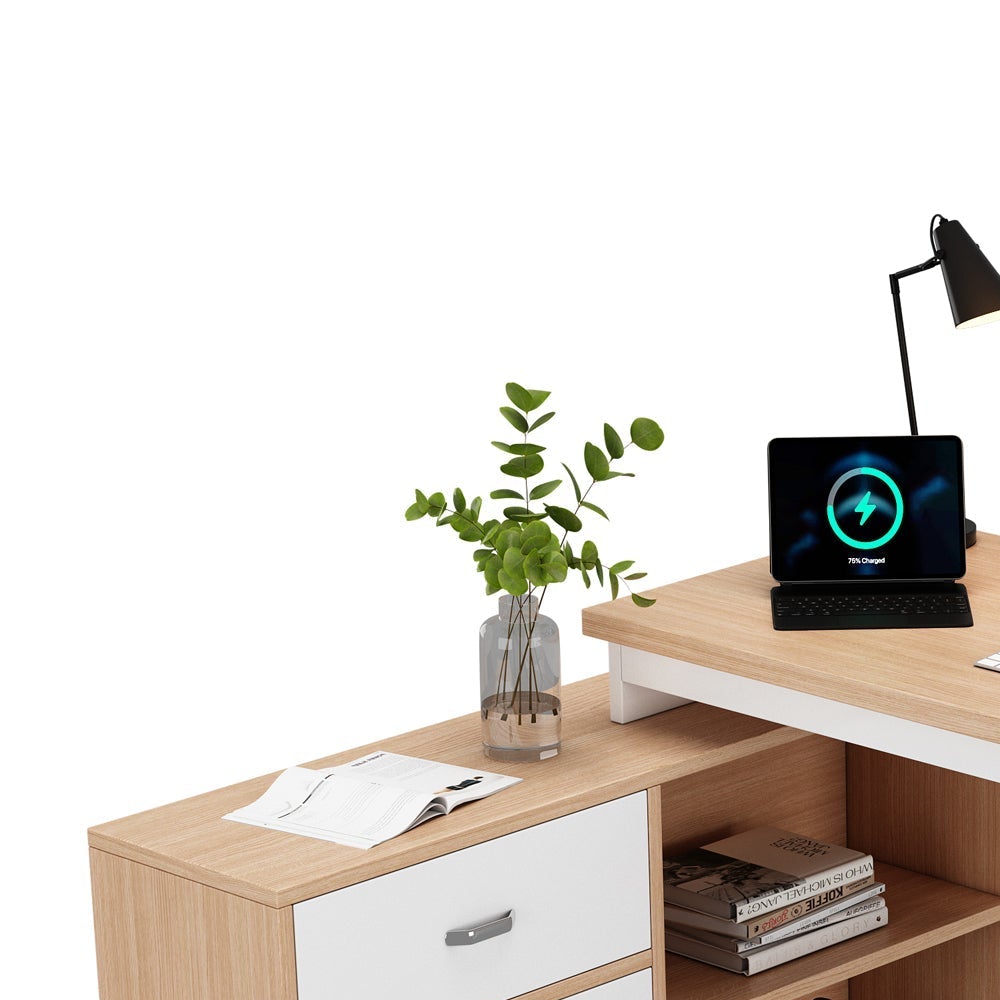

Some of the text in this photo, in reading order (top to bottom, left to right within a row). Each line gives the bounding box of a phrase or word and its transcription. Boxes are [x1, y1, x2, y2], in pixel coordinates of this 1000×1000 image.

[861, 557, 886, 565] Charged
[833, 873, 844, 883] IS
[845, 862, 873, 878] WHO
[785, 877, 832, 900] MICHAEL
[747, 895, 783, 914] JANG?
[805, 886, 844, 912] KOFFIE
